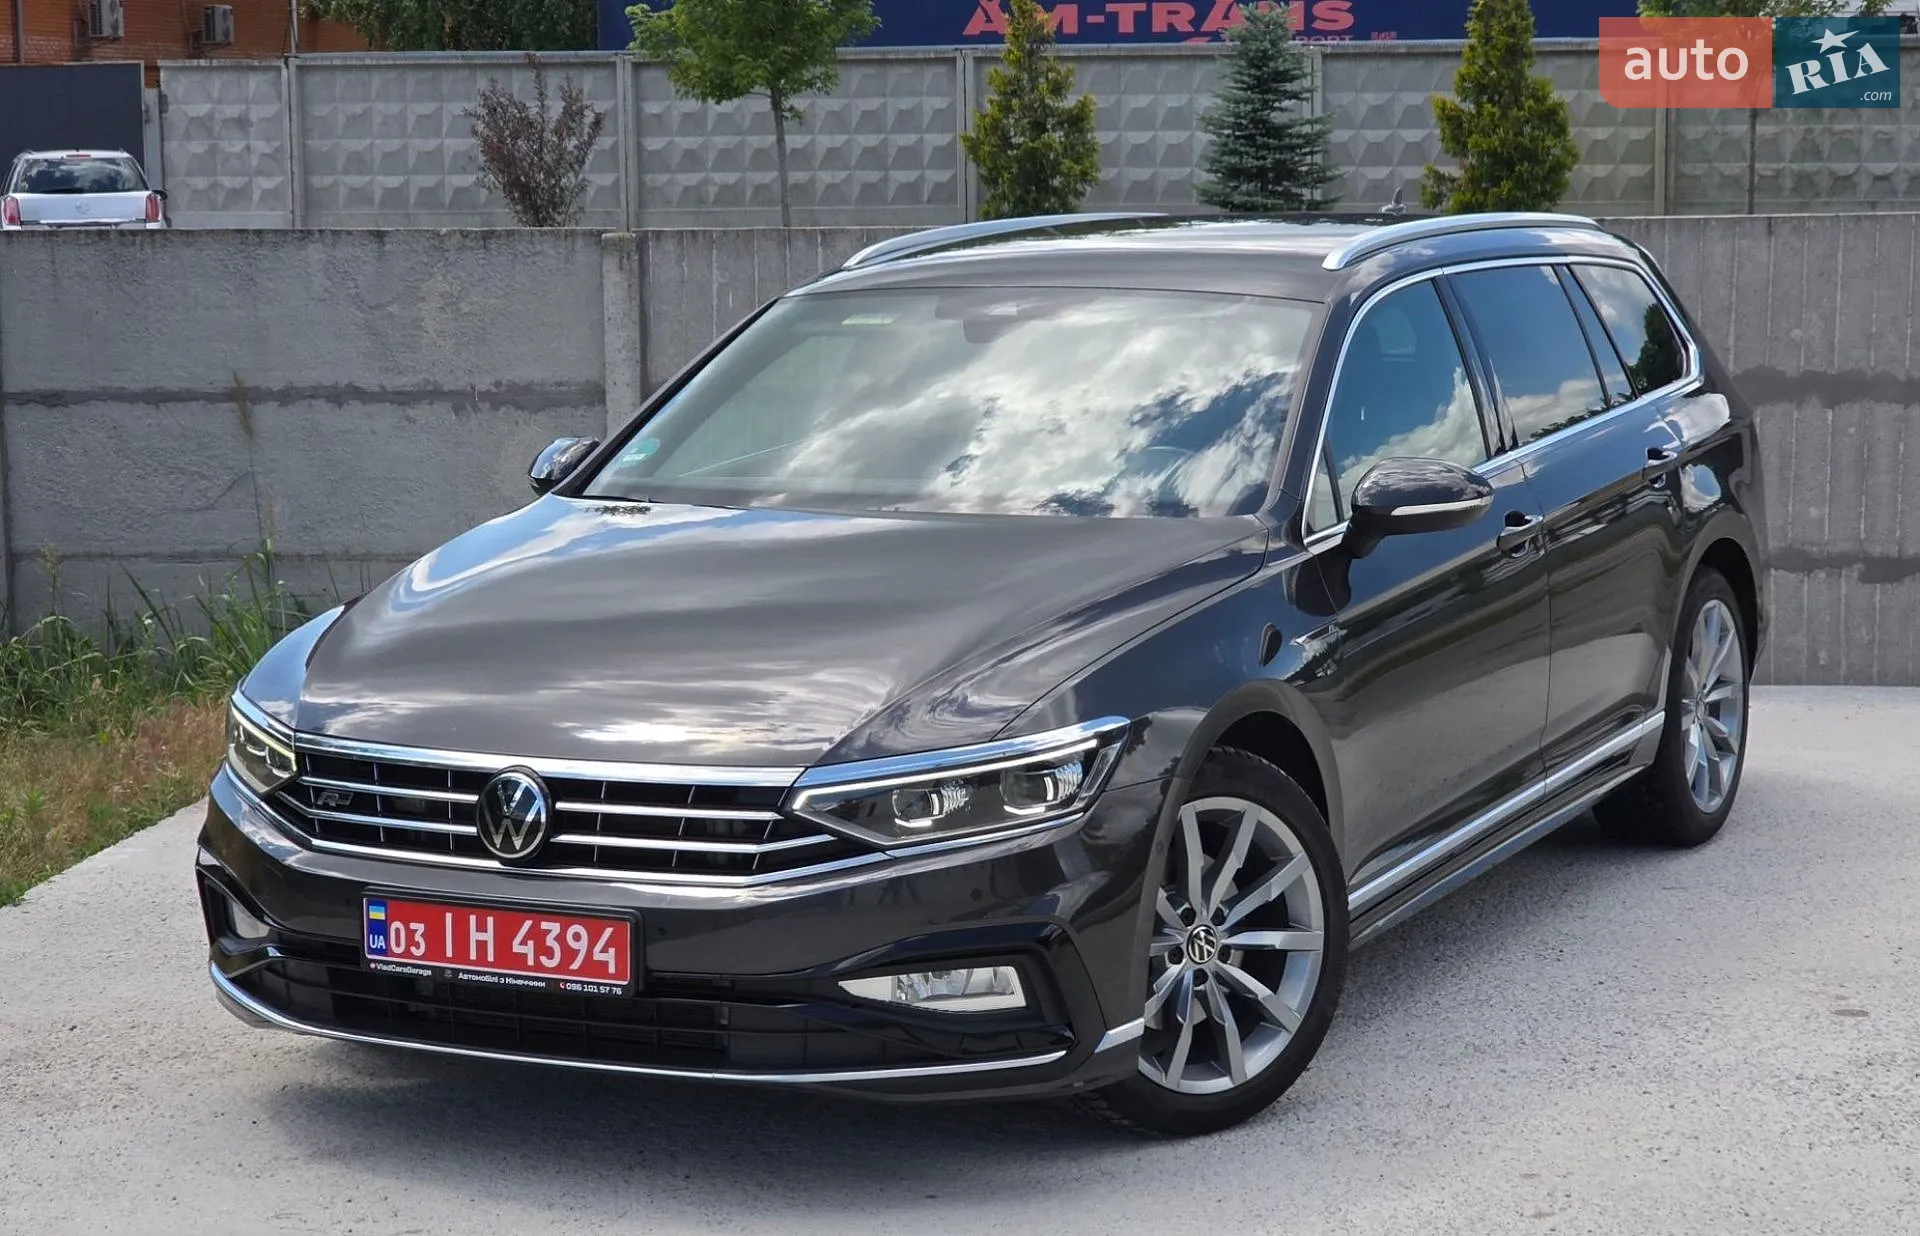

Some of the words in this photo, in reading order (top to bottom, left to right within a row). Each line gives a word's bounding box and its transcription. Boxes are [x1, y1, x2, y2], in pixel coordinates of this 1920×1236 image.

[369, 934, 386, 950] UA
[389, 921, 426, 957] 03
[512, 920, 616, 974] 4394
